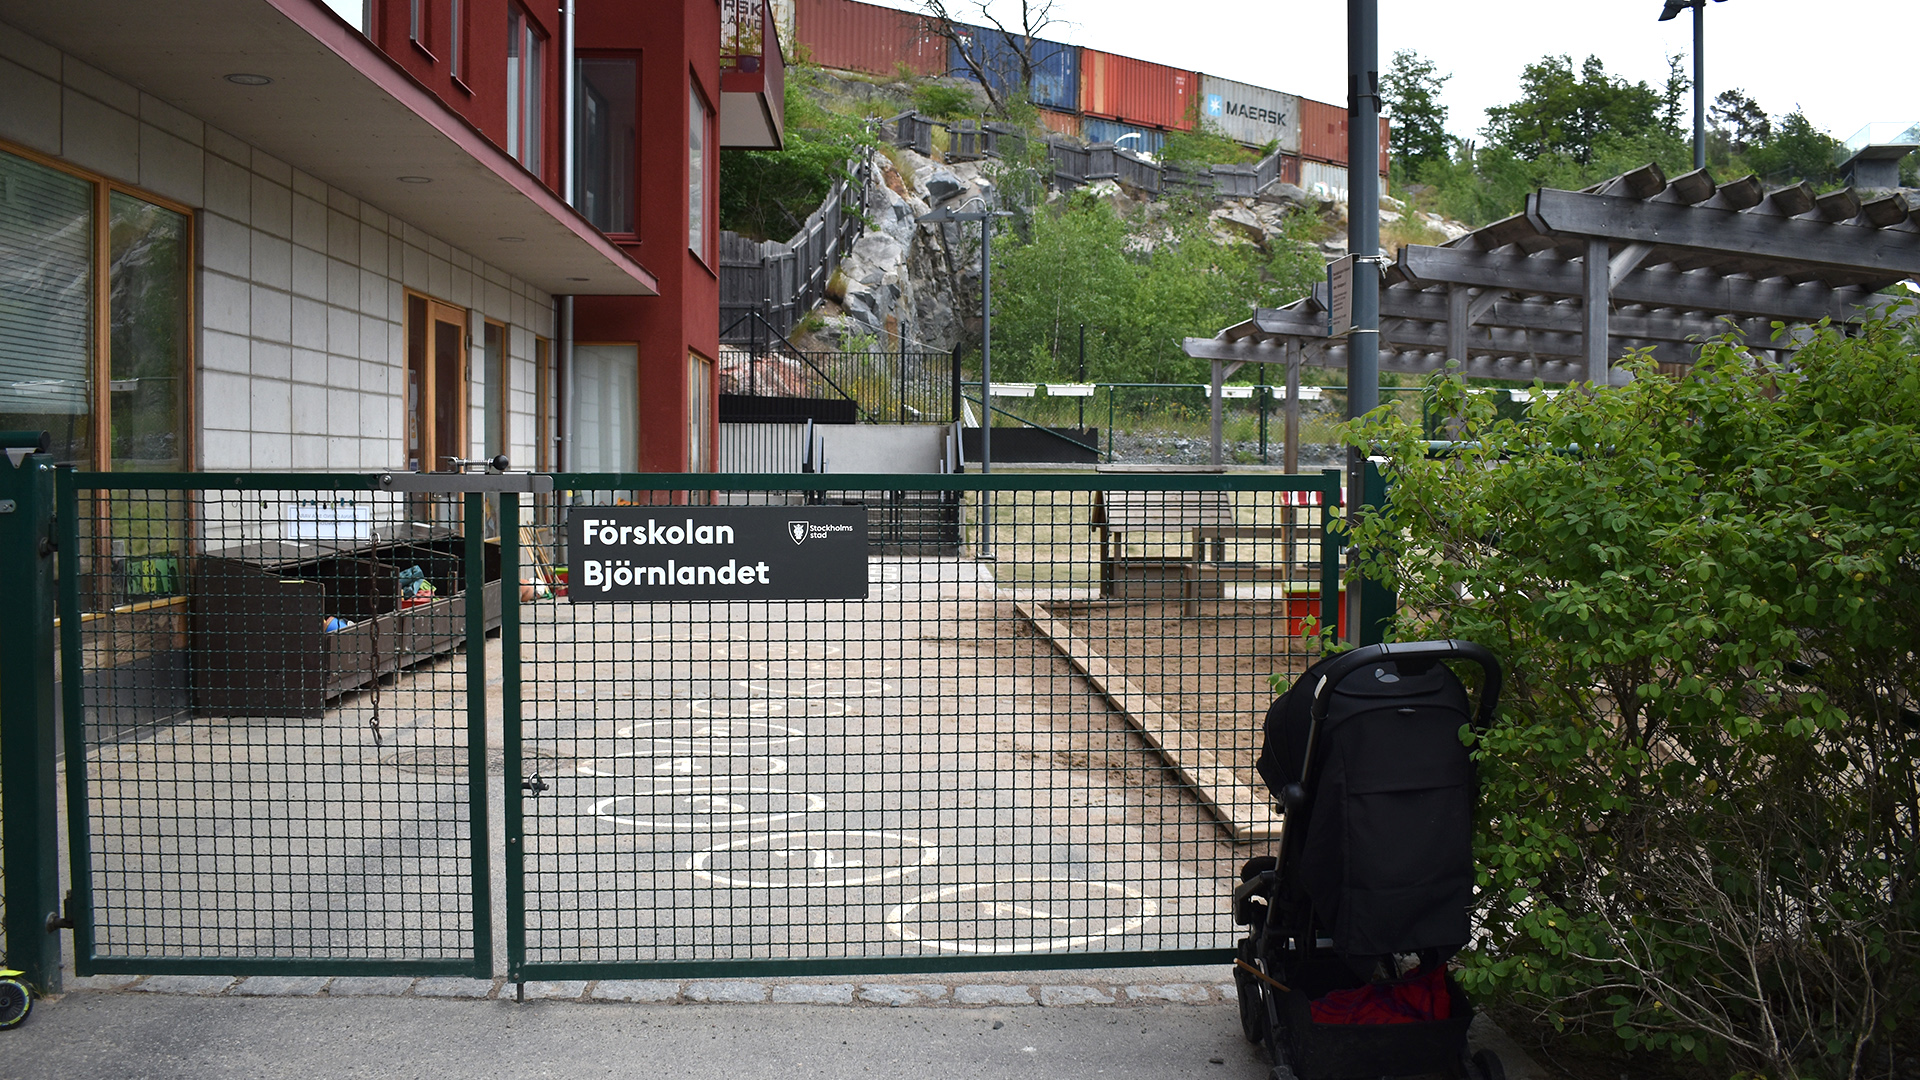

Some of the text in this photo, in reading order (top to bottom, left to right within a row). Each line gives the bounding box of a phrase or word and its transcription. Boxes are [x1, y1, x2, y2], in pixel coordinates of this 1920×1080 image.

[1226, 101, 1287, 126] MAERSK
[583, 518, 734, 546] Förskolan
[809, 524, 853, 532] Stockholms
[810, 531, 827, 539] stad
[583, 559, 770, 592] Björnlandet
[654, 757, 702, 773] 4
